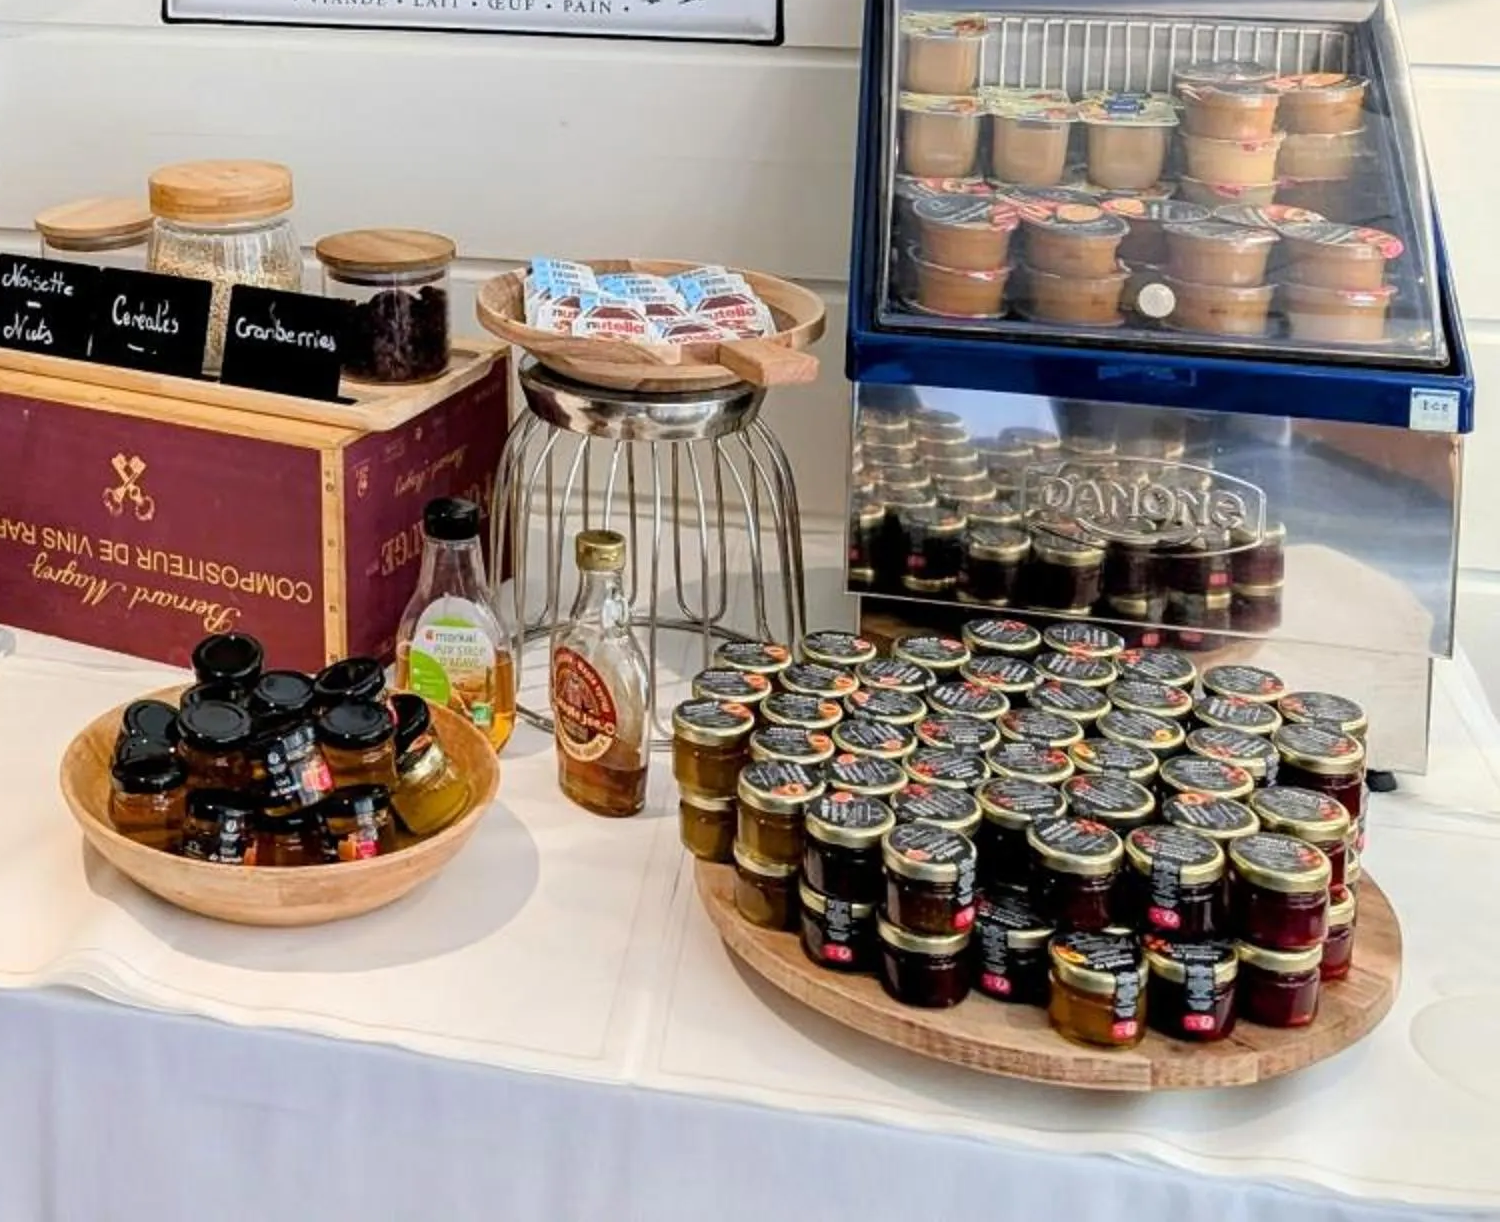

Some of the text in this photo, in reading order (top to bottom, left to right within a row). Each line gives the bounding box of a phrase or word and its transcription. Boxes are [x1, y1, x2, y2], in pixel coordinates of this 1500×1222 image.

[1, 262, 74, 298] Noisette
[3, 313, 55, 345] Nuts
[235, 301, 337, 352] Cranberries
[42, 526, 94, 559] VINS
[99, 539, 131, 567] DE
[136, 546, 314, 604] COMPOSITEUR
[129, 582, 243, 635] Bernard
